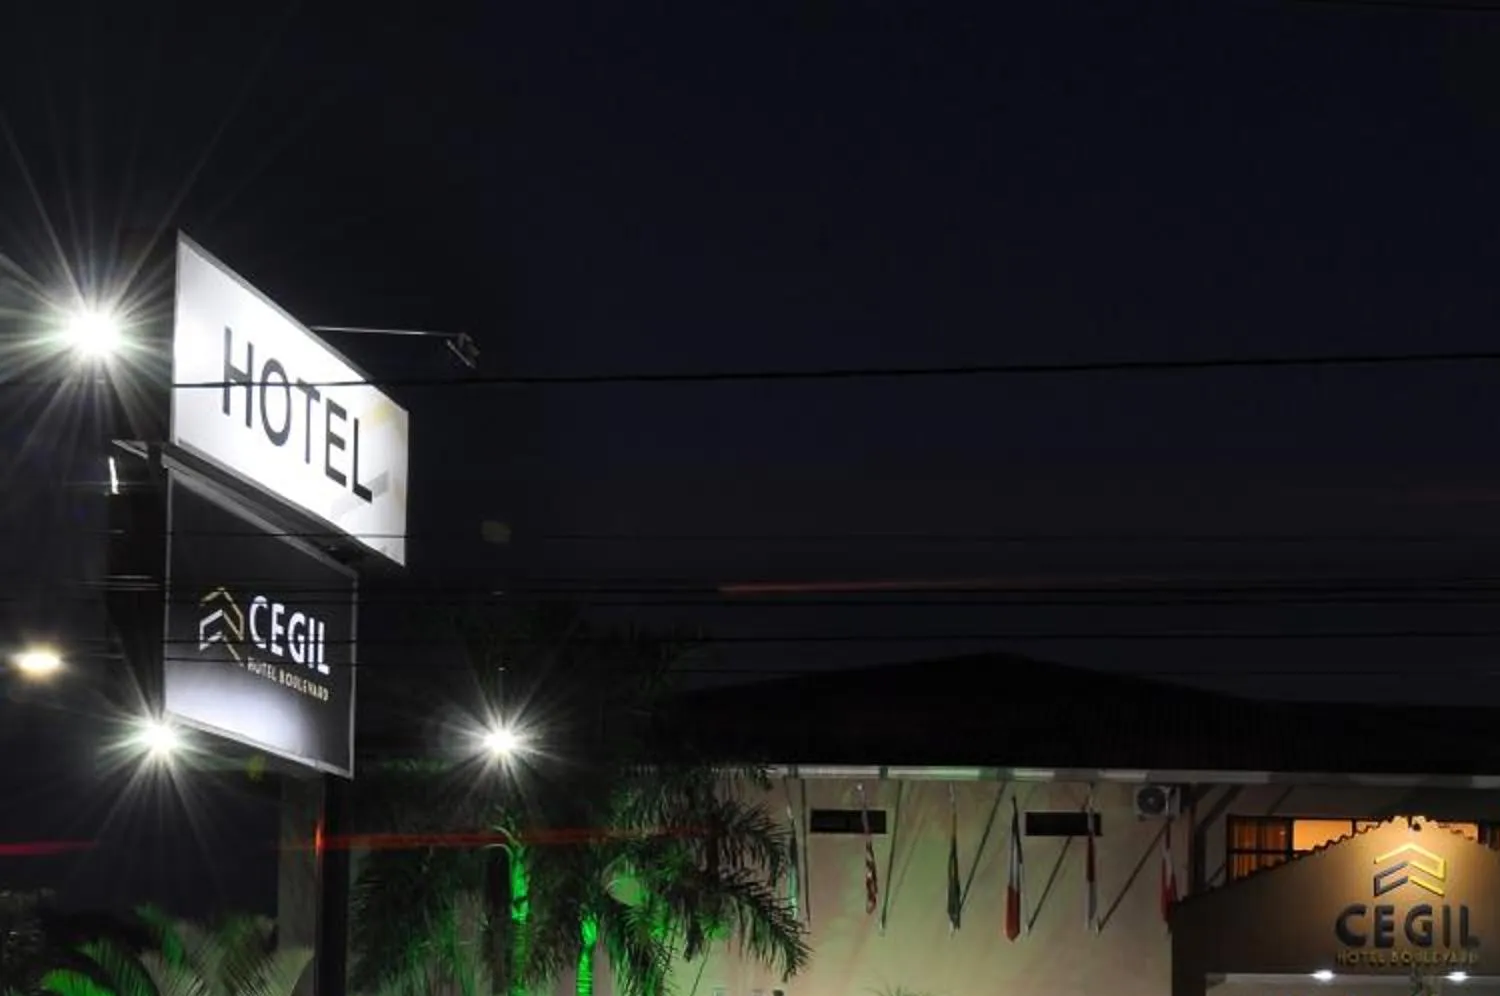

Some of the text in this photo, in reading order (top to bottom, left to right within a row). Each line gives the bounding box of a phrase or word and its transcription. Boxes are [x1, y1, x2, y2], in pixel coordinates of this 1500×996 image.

[223, 325, 372, 504] HOTEL
[249, 595, 330, 675] CEGIL
[1335, 903, 1481, 949] CEGIL
